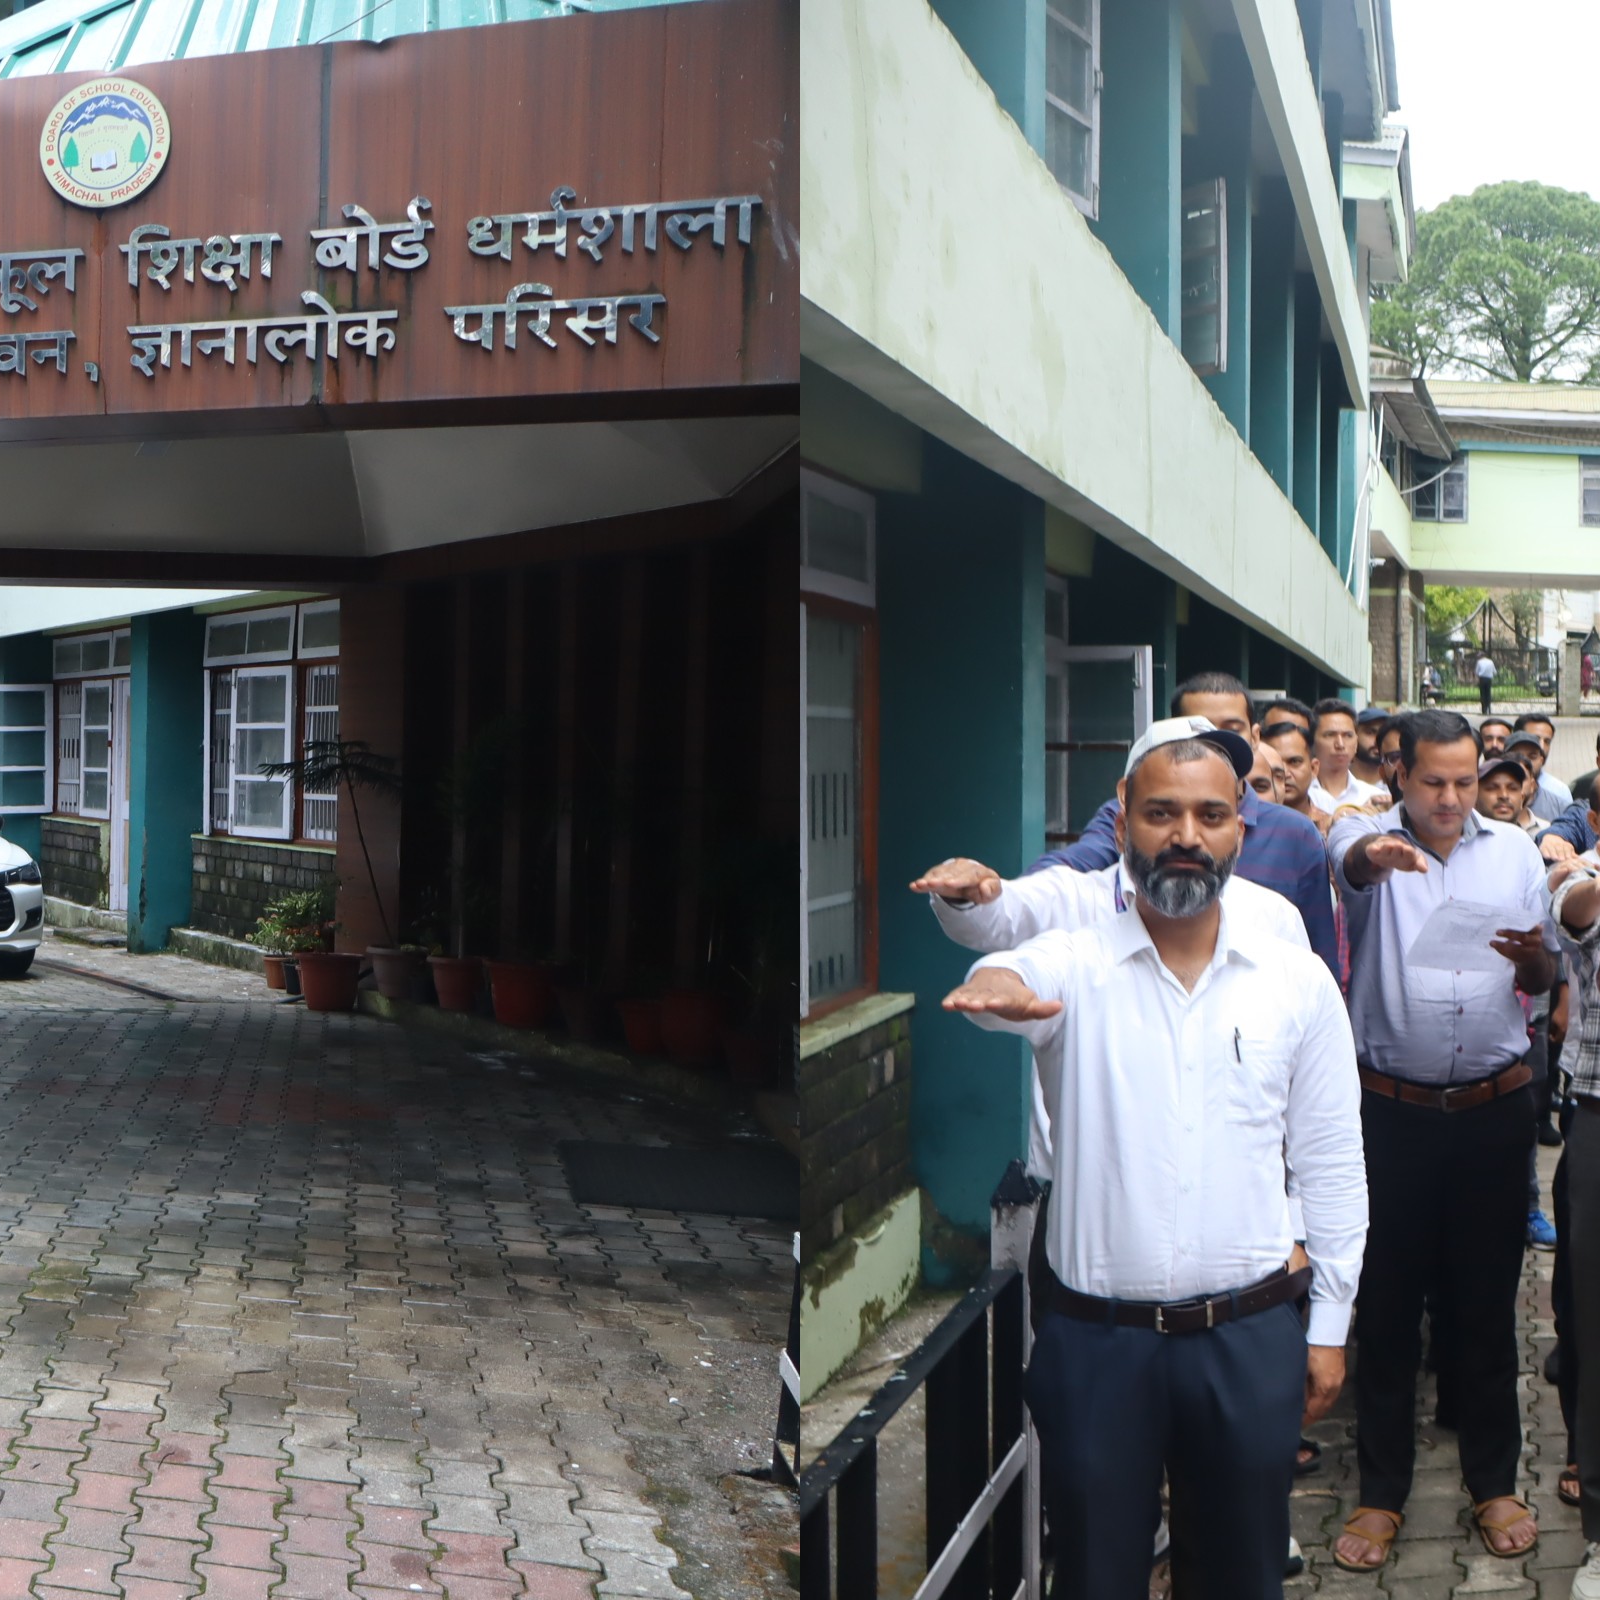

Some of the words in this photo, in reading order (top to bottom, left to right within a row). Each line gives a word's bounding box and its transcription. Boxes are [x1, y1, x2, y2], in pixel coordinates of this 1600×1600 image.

[45, 112, 64, 152] BOARD
[63, 97, 77, 111] OF
[79, 83, 127, 99] SCHOOL
[129, 88, 165, 144] EDUCATION
[53, 170, 105, 202] HIMACHAL
[110, 164, 156, 201] PRADESH
[118, 224, 283, 292] शिक्षा
[310, 194, 435, 272] बोर्ड
[466, 185, 763, 263] धर्मशाला
[126, 290, 398, 377] ज्ञानालोक
[443, 282, 667, 351] परिसर
